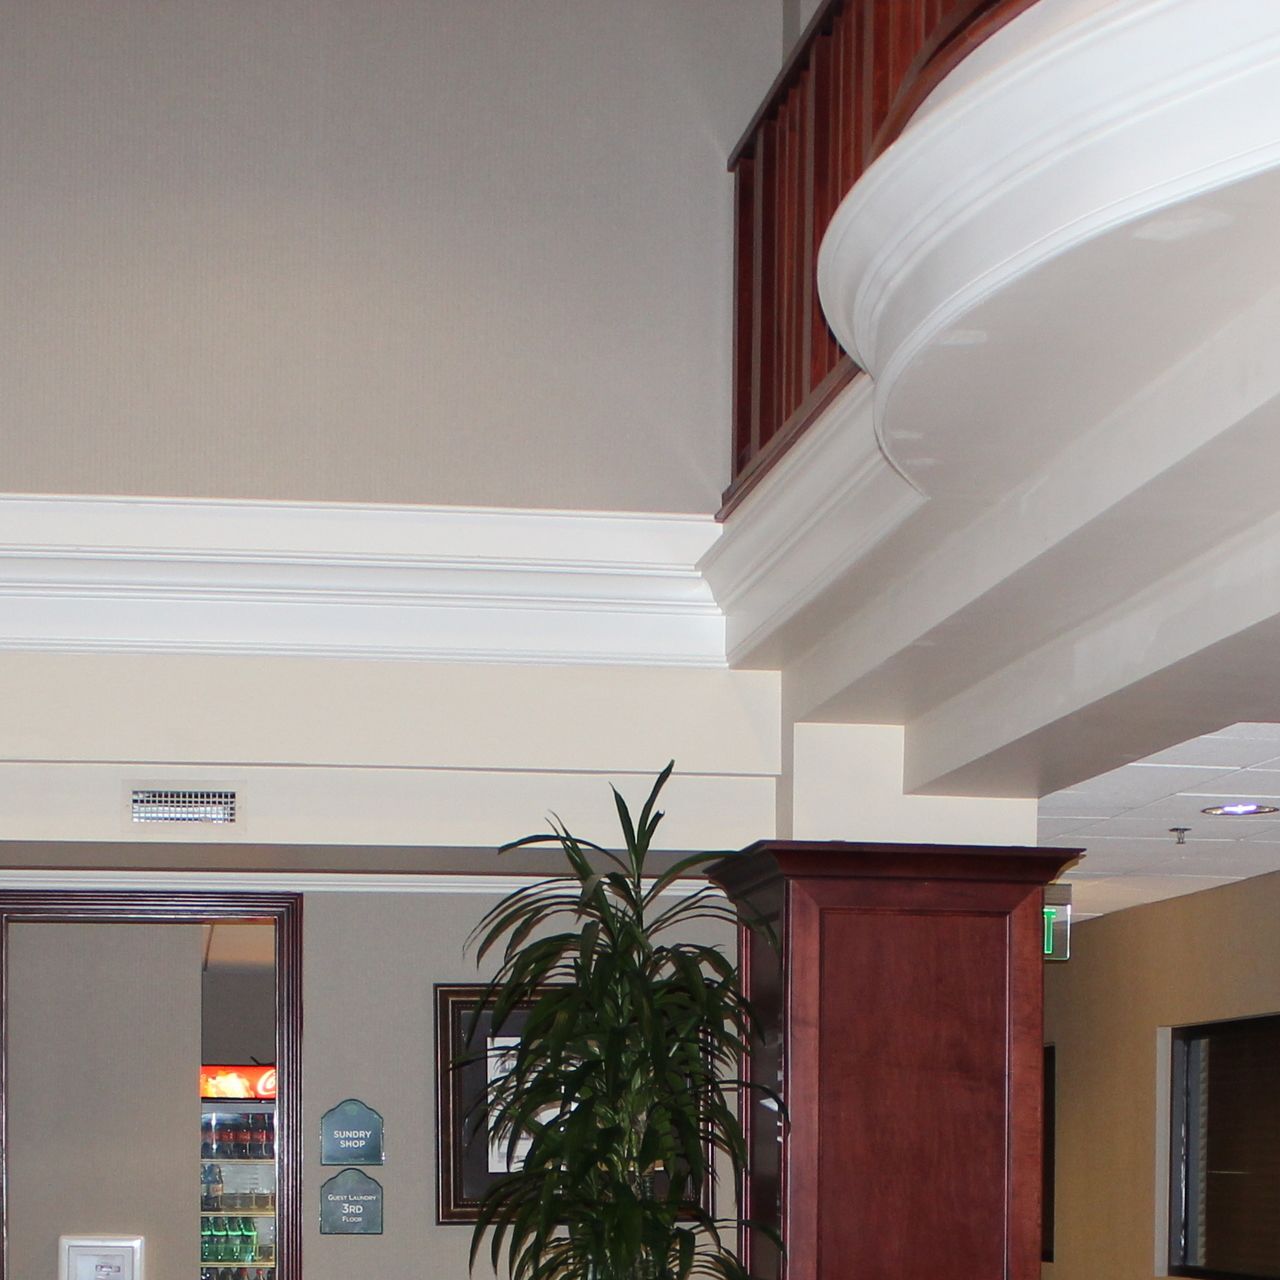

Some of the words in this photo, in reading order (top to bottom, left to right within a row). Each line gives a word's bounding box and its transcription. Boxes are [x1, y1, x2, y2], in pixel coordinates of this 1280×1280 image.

[333, 1130, 372, 1139] SUNDRY
[340, 1140, 366, 1148] SHOP
[342, 1203, 363, 1214] 3RD
